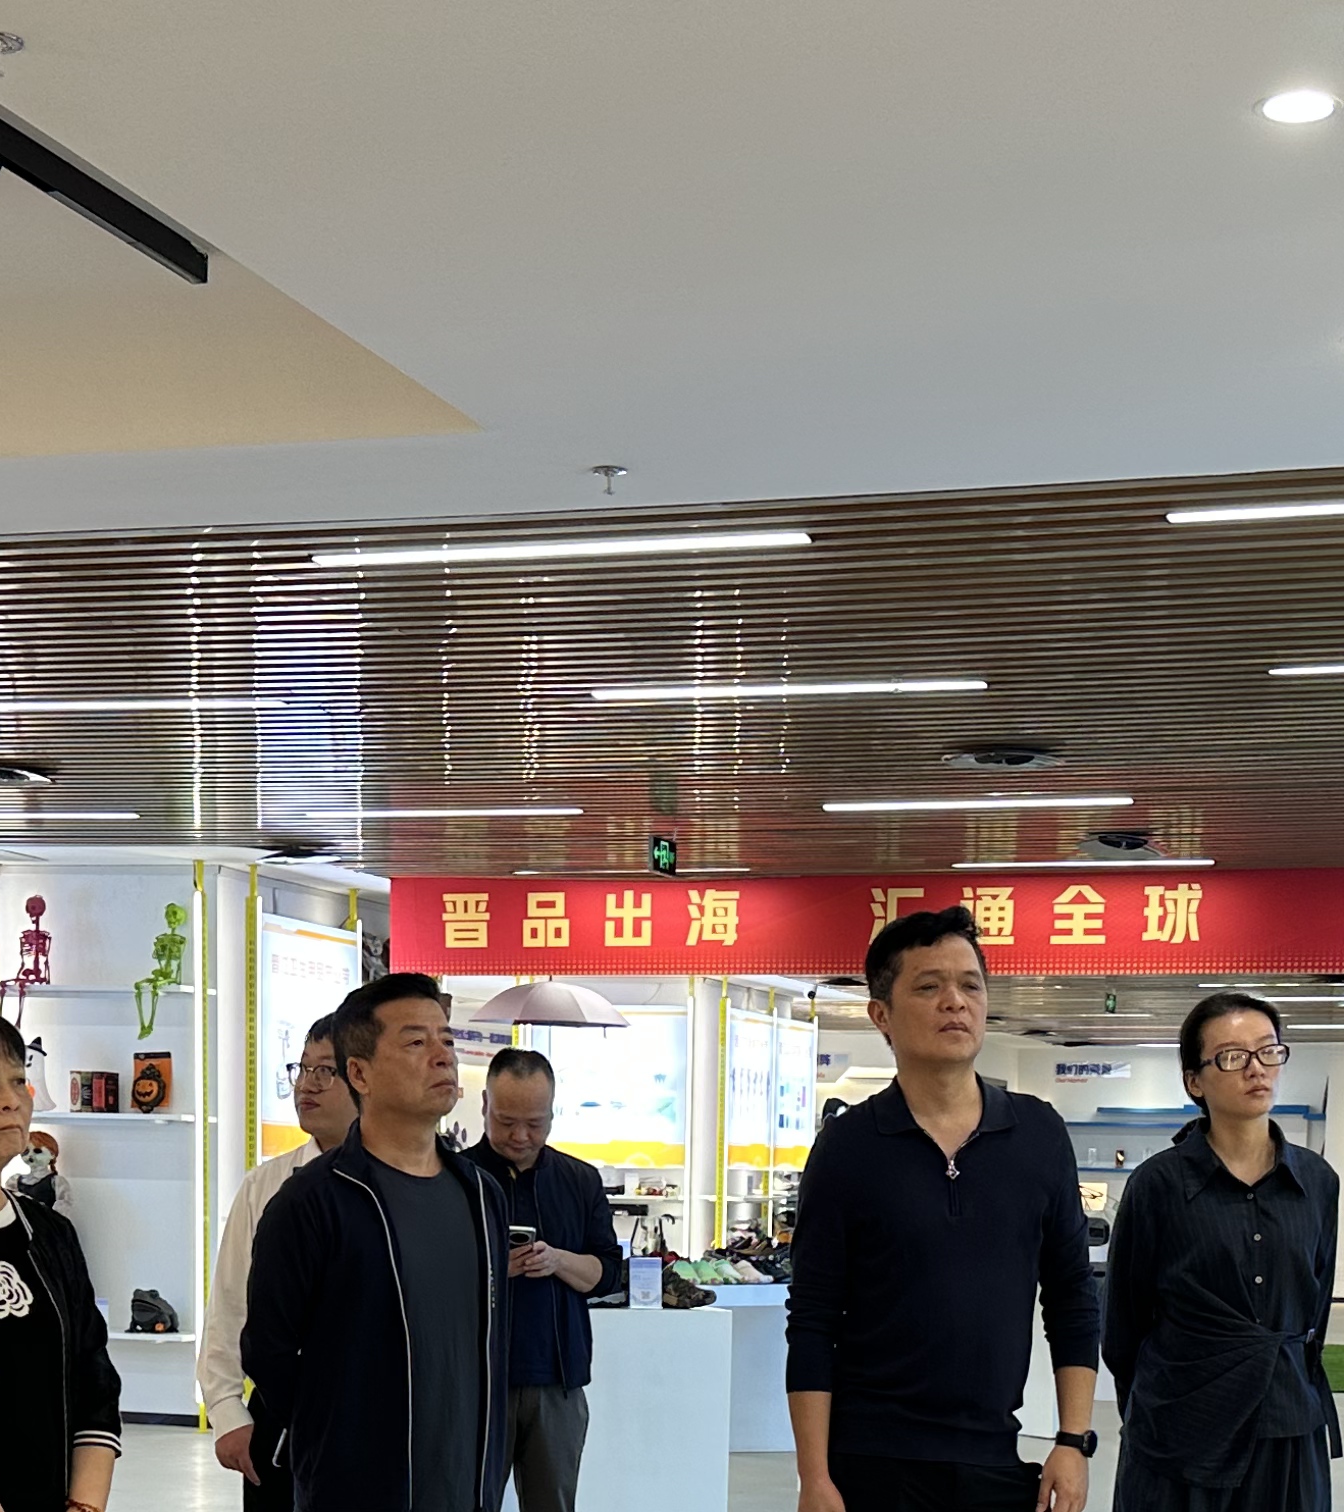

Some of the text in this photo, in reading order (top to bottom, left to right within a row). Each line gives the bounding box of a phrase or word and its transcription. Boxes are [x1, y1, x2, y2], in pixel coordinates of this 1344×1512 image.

[442, 889, 740, 948] 晋品出海
[869, 883, 1203, 944] 汇通全球
